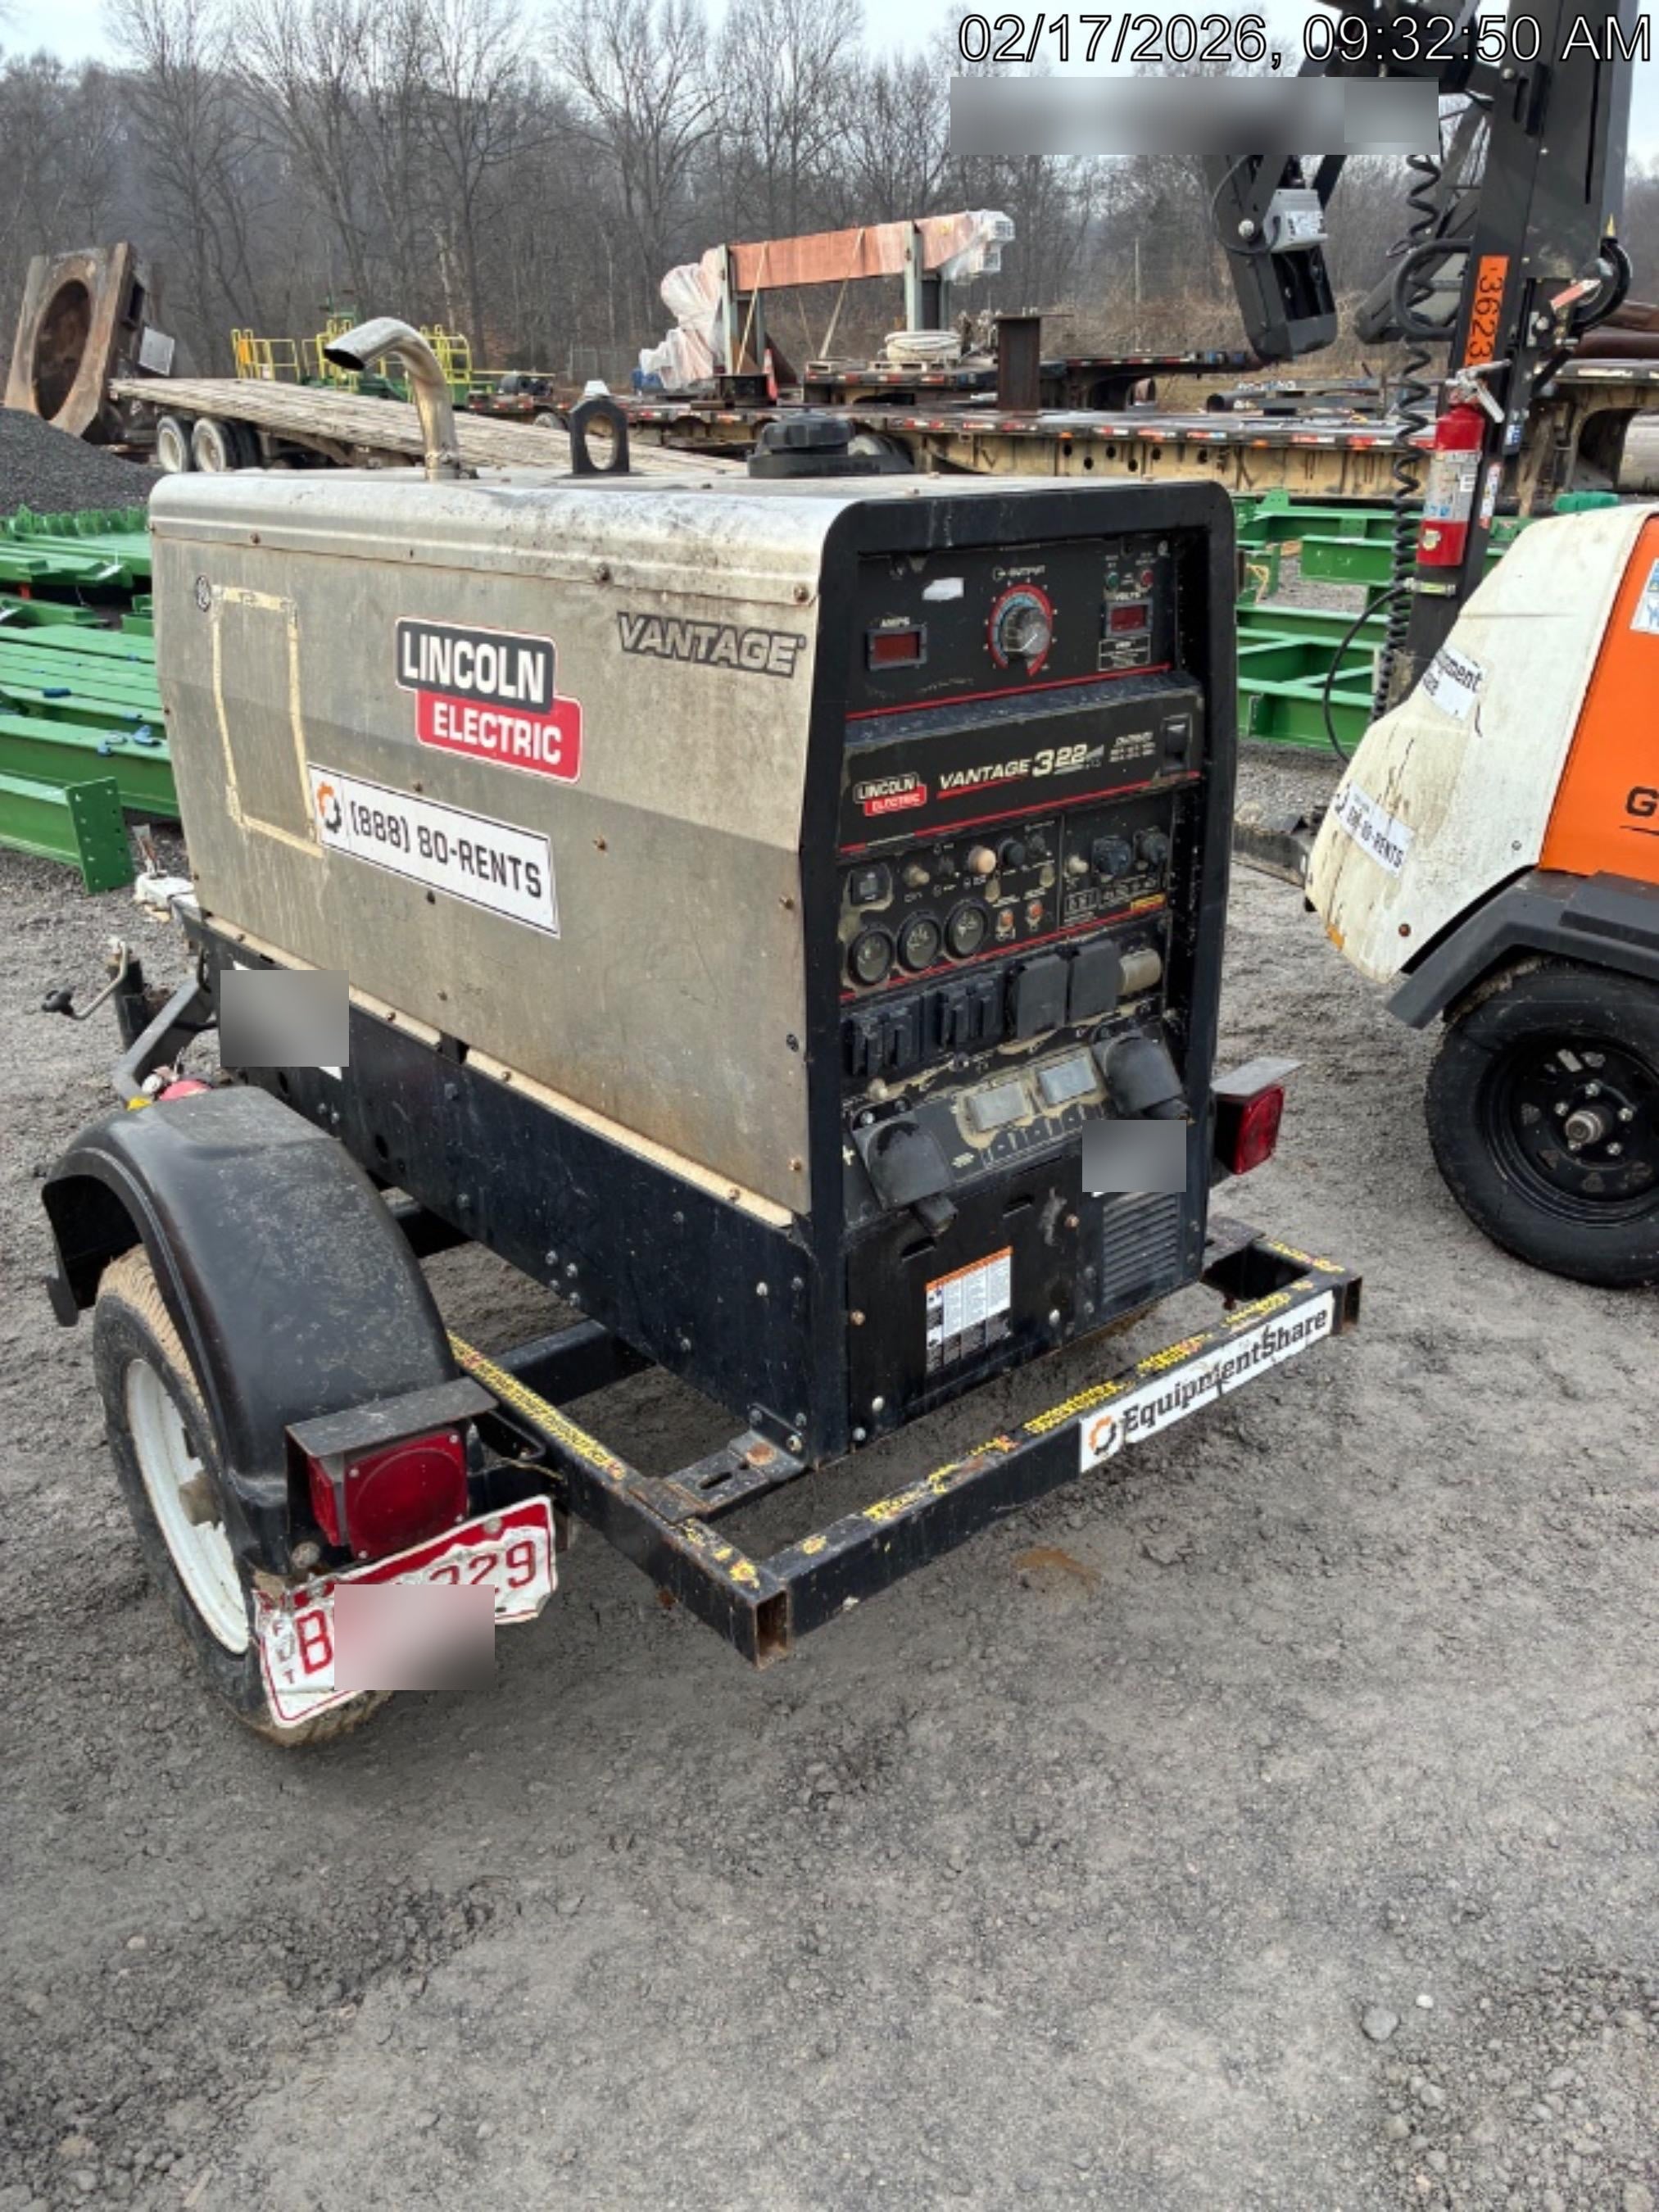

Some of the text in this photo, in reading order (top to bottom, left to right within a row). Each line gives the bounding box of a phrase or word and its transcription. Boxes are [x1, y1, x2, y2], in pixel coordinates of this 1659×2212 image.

[402, 631, 546, 704] LINCOLN
[617, 611, 800, 678] VANTAGE
[433, 702, 563, 765] ELECTRIC
[940, 758, 1032, 790] VANTAGE
[1031, 743, 1088, 777] 322
[858, 776, 917, 800] LINCOLN
[350, 798, 543, 900] (888) 80-RENTS
[1122, 1308, 1328, 1434] EquipmentShare
